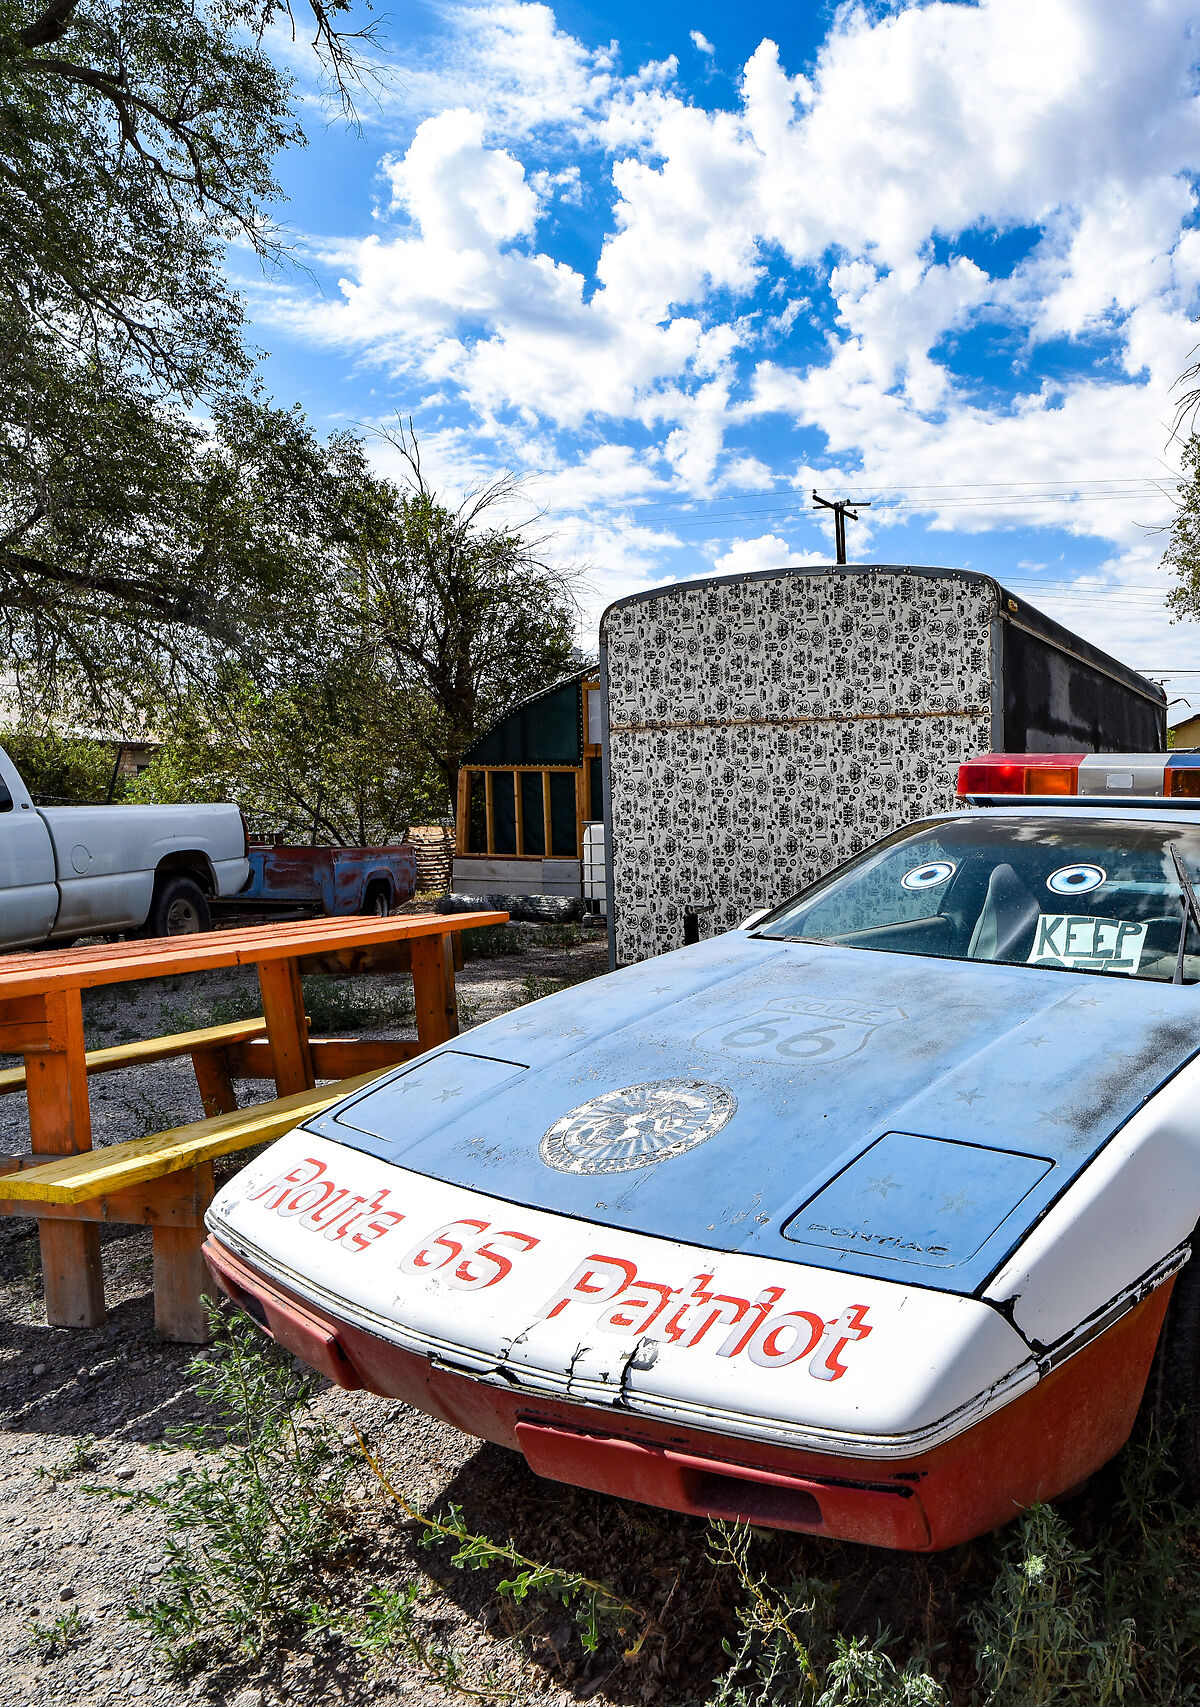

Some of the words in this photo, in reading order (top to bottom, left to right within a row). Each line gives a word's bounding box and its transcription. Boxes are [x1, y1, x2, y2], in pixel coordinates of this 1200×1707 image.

[1037, 916, 1143, 959] KEEP
[783, 1001, 883, 1021] ROUTE
[720, 1016, 846, 1058] 66
[807, 1223, 950, 1257] PONTIAC
[246, 1157, 406, 1253] Route
[399, 1218, 541, 1291] 66
[533, 1253, 874, 1383] Patriot
